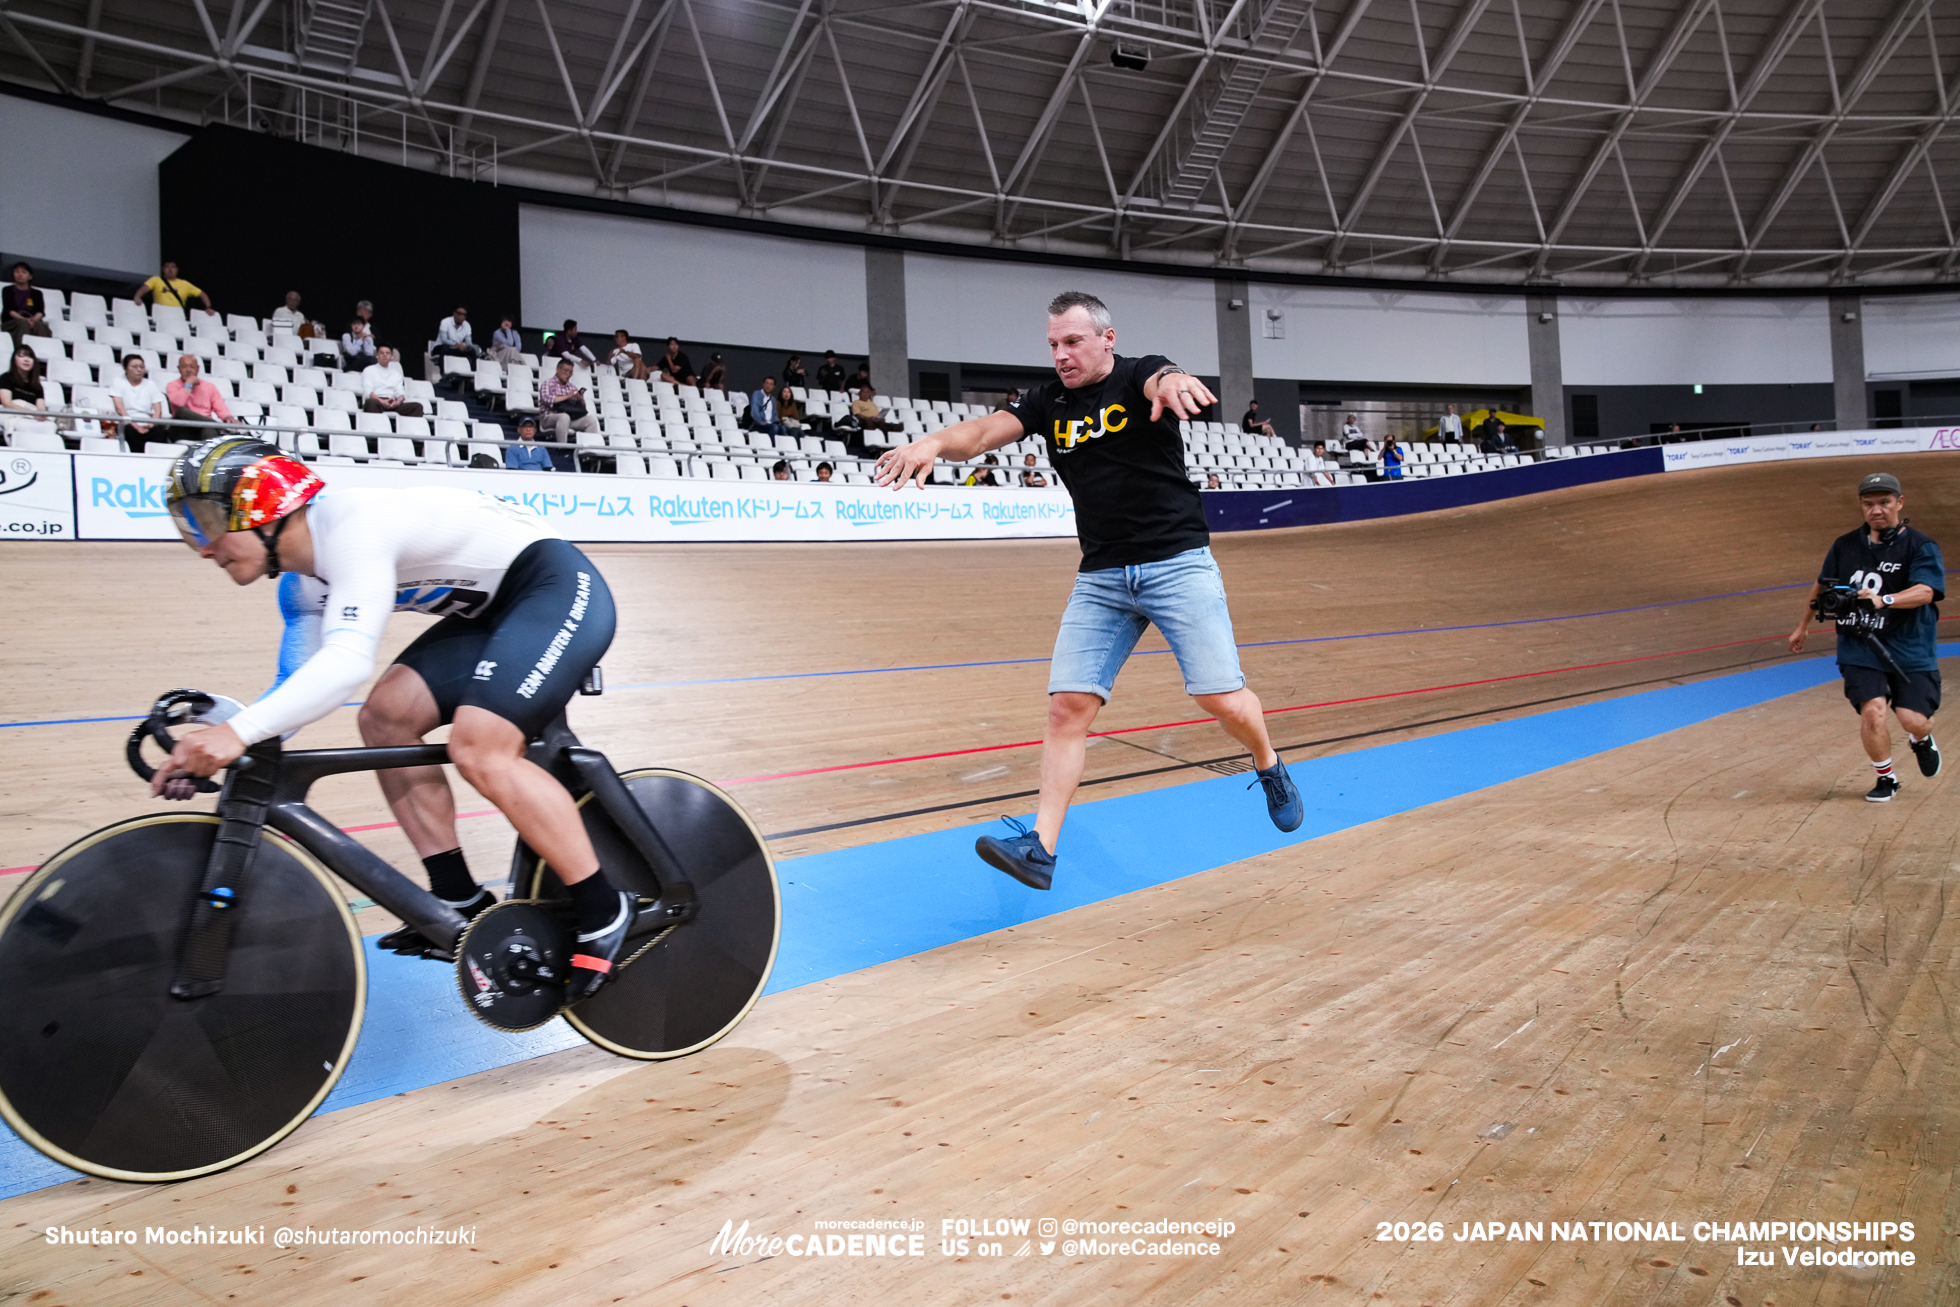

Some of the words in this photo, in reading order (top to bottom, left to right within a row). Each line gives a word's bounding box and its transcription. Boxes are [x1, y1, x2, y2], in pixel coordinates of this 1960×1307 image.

[650, 495, 733, 518] Rakuten
[737, 499, 824, 518] Kドリームス
[836, 499, 902, 519] Rakuten
[905, 502, 973, 519] Kドリームス
[983, 502, 1036, 519] Rakuten
[0, 521, 62, 535] .co.jp
[516, 669, 546, 698] TEAM
[535, 629, 573, 675] RAKUTEN
[563, 619, 579, 631] K
